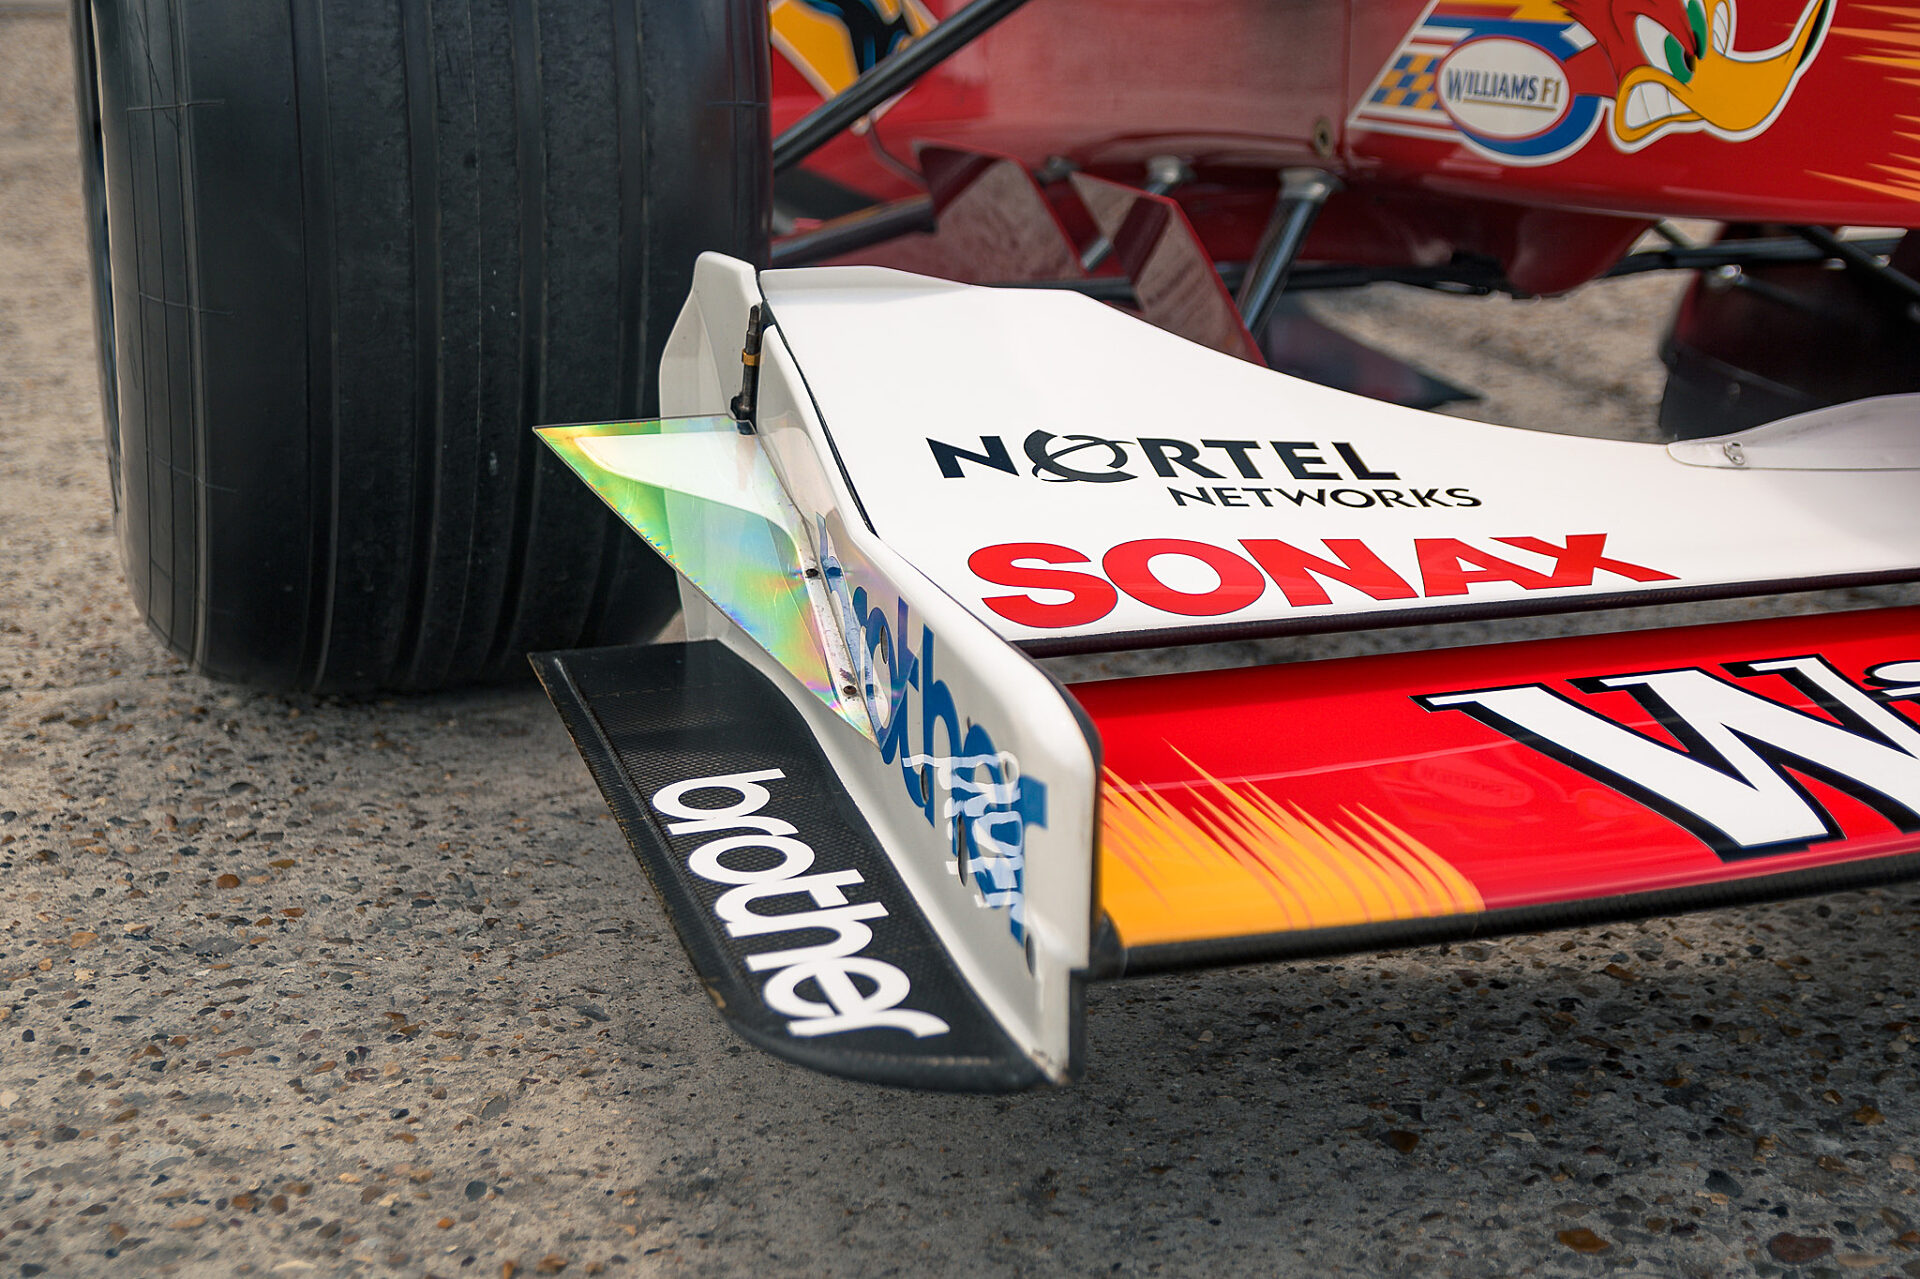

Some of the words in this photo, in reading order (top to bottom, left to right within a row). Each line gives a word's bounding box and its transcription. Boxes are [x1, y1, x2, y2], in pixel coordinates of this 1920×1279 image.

[1447, 67, 1538, 104] WILLIAMS
[1540, 76, 1562, 105] F1
[926, 429, 1402, 483] NORTEL
[1166, 486, 1483, 508] NETWORKS
[967, 533, 1680, 629] SONAX
[652, 768, 950, 1037] brother
